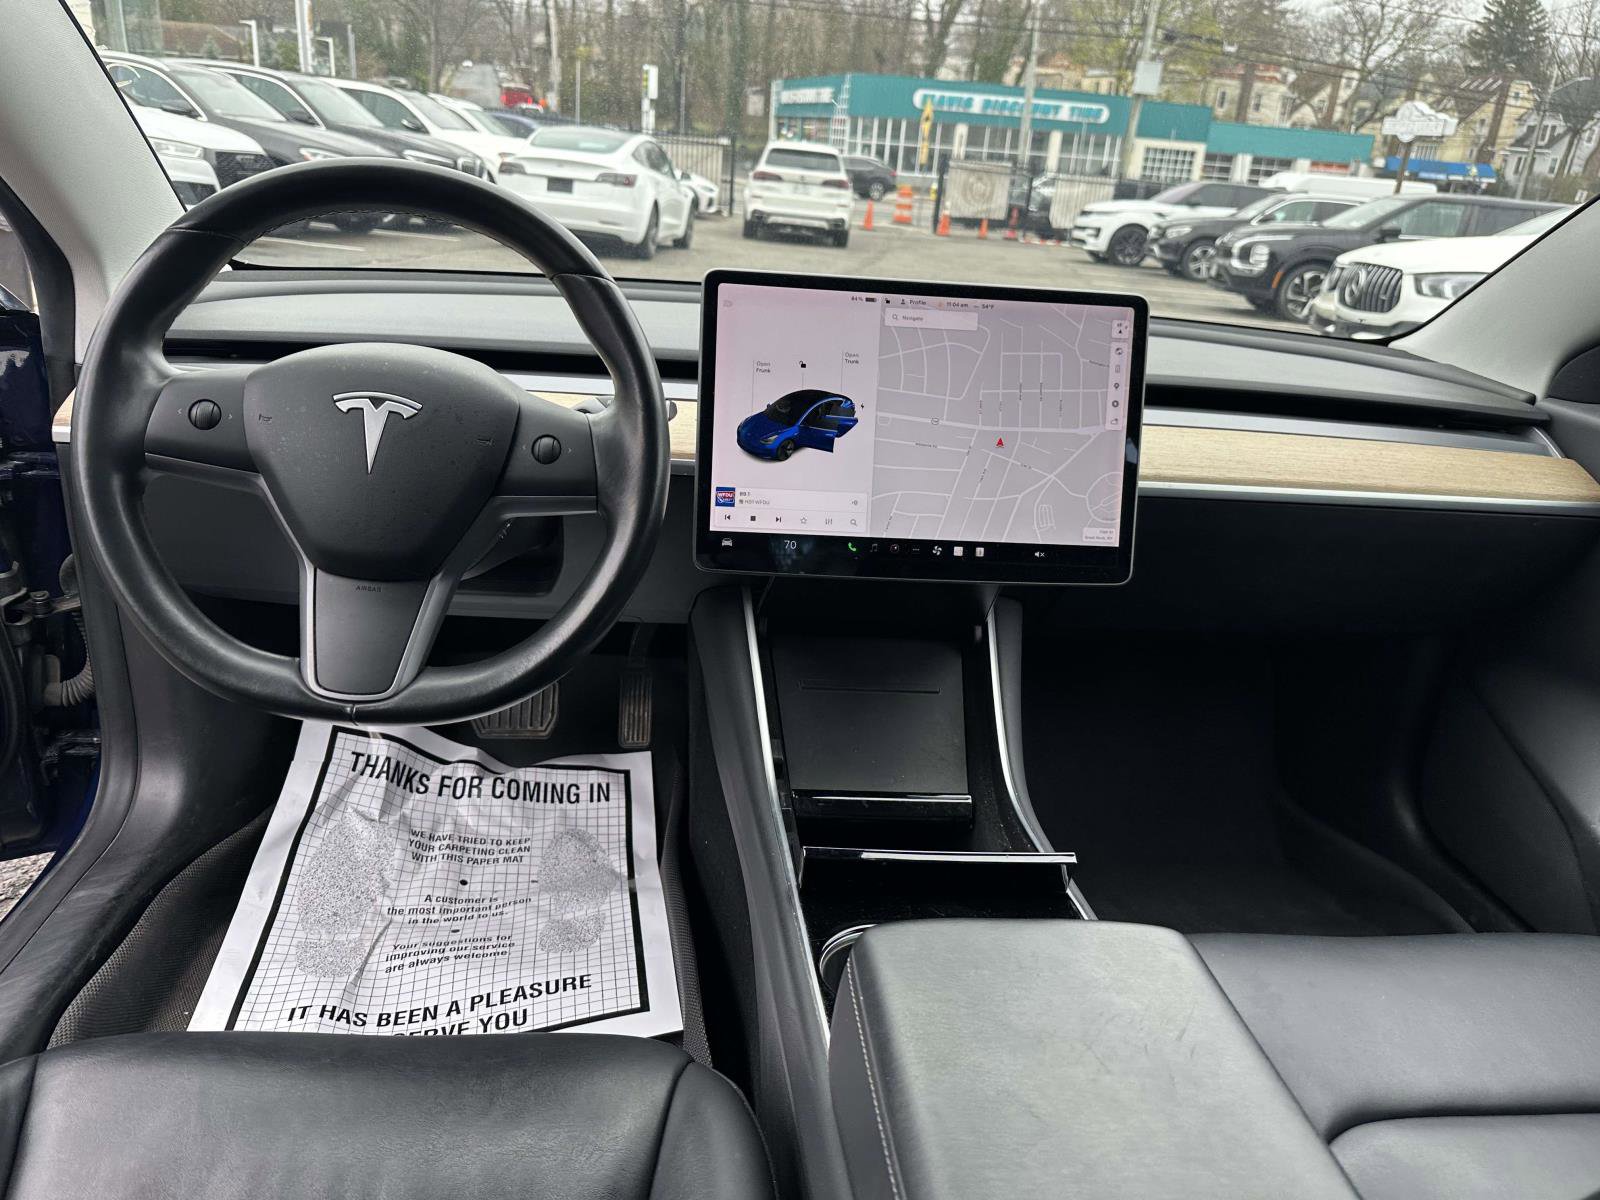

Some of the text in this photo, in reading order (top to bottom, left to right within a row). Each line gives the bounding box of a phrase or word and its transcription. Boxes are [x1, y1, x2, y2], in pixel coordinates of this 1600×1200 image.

[784, 540, 797, 550] 70
[350, 751, 610, 804] THANKS FOR COMING IN
[411, 829, 531, 846] WE HAVE TRIED TO KEEP
[409, 839, 531, 856] YOUR CARPETING CLEAN
[412, 852, 524, 865] WITH THIS PAPER MAT
[387, 898, 532, 915] the most important person
[424, 894, 432, 903] A
[435, 896, 485, 905] customer
[443, 914, 474, 922] world
[422, 935, 492, 947] suggestions
[385, 947, 446, 962] improving
[472, 941, 515, 951] service
[385, 963, 404, 973] are
[408, 954, 450, 968] always
[288, 974, 592, 1027] IT HAS BEEN A PLEASURE
[479, 1008, 527, 1033] YOU
